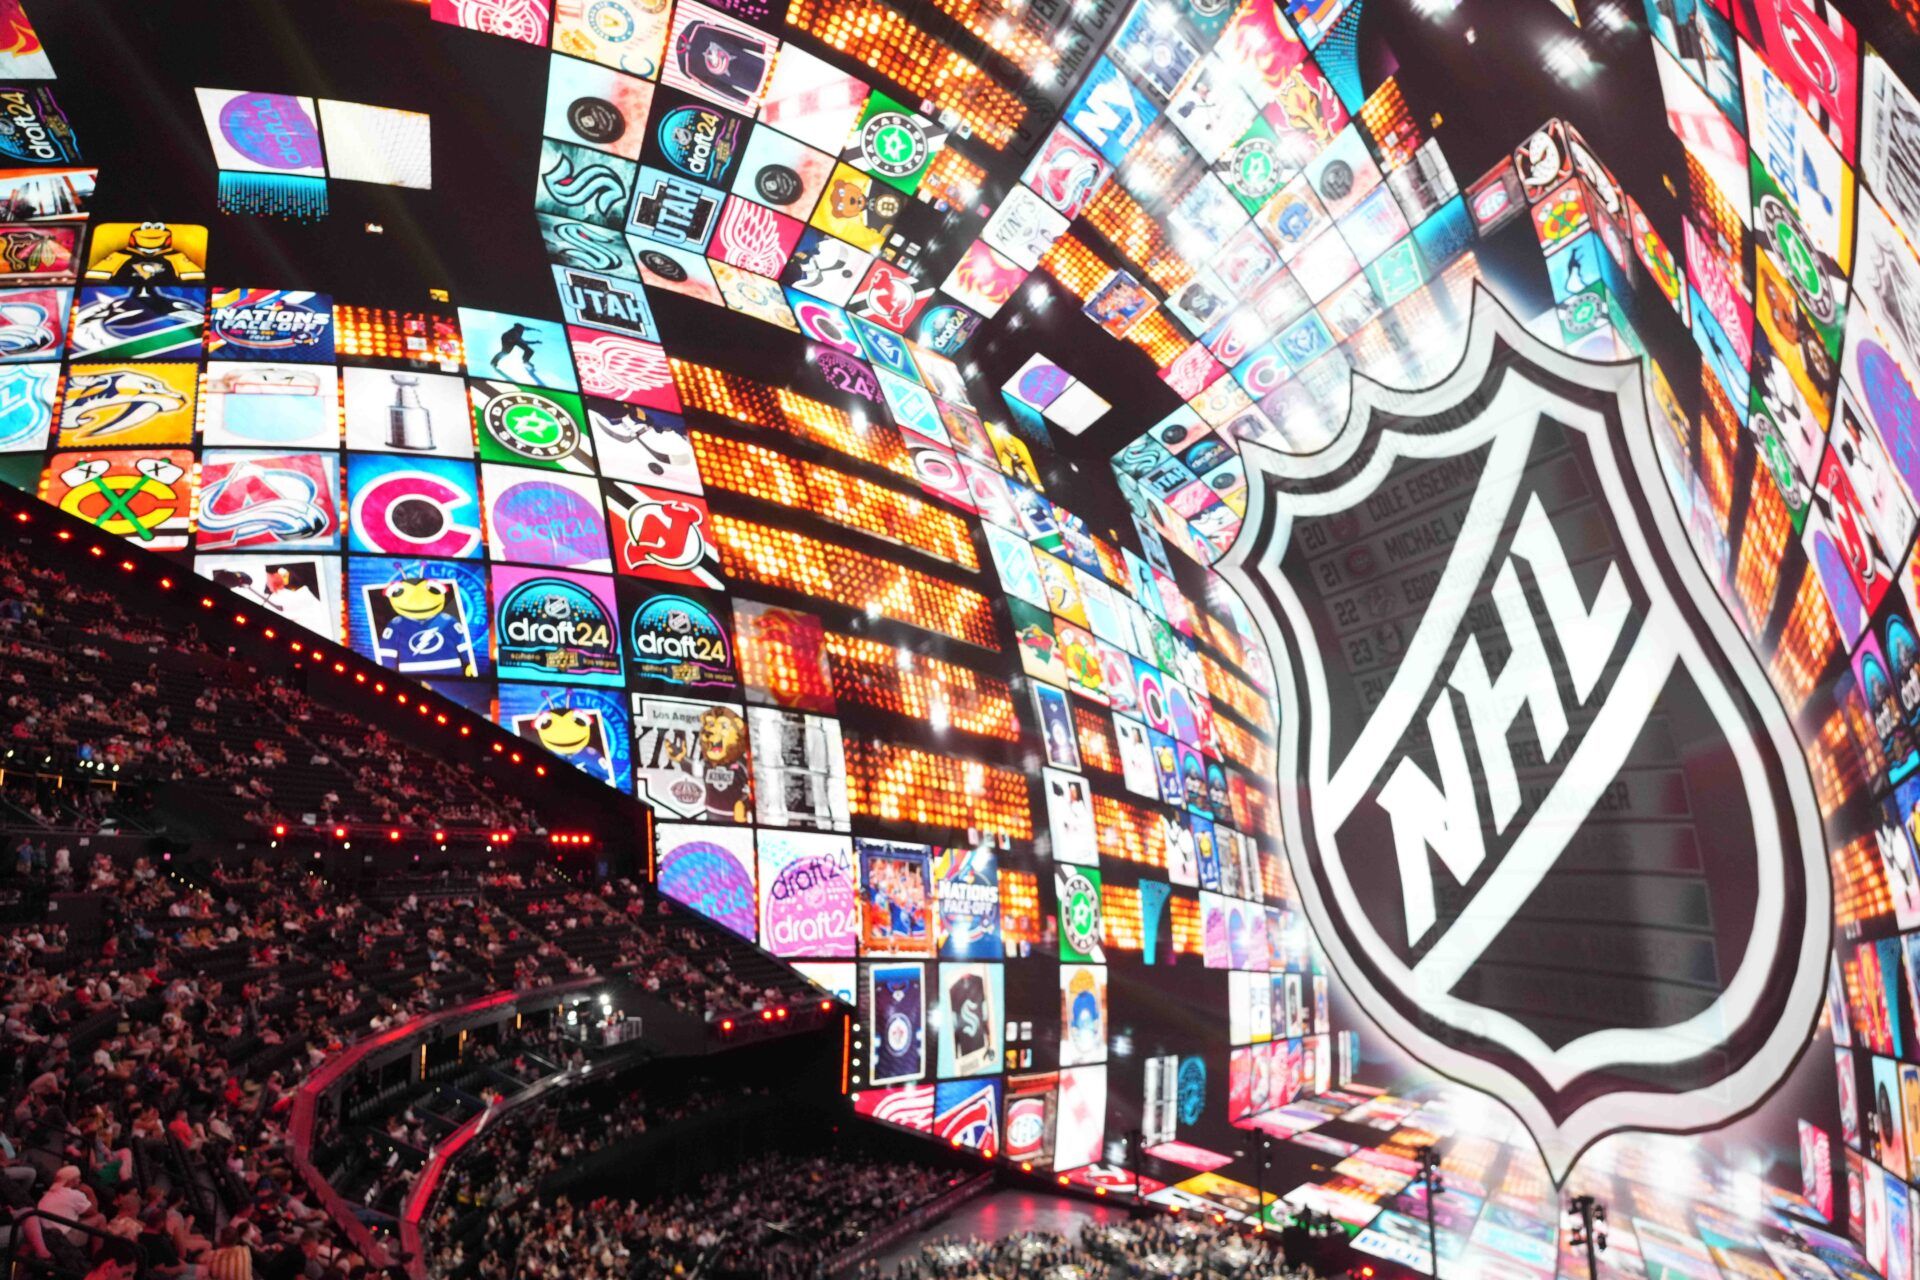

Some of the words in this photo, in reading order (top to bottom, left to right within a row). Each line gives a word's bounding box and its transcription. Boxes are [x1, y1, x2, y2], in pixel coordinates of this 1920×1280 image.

[688, 112, 720, 174] draft24
[653, 178, 703, 244] UTAH
[215, 307, 331, 325] NATIONS
[561, 283, 652, 326] UTAH
[222, 319, 318, 333] FACE-OFF
[491, 396, 571, 427] DALLAS
[499, 430, 572, 457] STARS
[1151, 466, 1186, 490] UTAH
[507, 516, 599, 543] draft24
[1302, 522, 1327, 550] 20
[1366, 493, 1402, 523] COLE
[1319, 561, 1342, 588] 21
[1383, 517, 1456, 563] MICHAEL
[431, 566, 486, 625] LIGHTNING
[1333, 598, 1360, 627] 22
[508, 617, 610, 648] draft24
[638, 631, 726, 663] draft24
[575, 695, 628, 761] LIGHTNING
[653, 710, 670, 719] Los
[672, 712, 700, 725] Angel
[1376, 490, 1633, 947] NHL
[709, 771, 733, 781] KINGS
[772, 847, 850, 901] draft24
[939, 881, 999, 904] NATIONS
[775, 909, 857, 944] draft24
